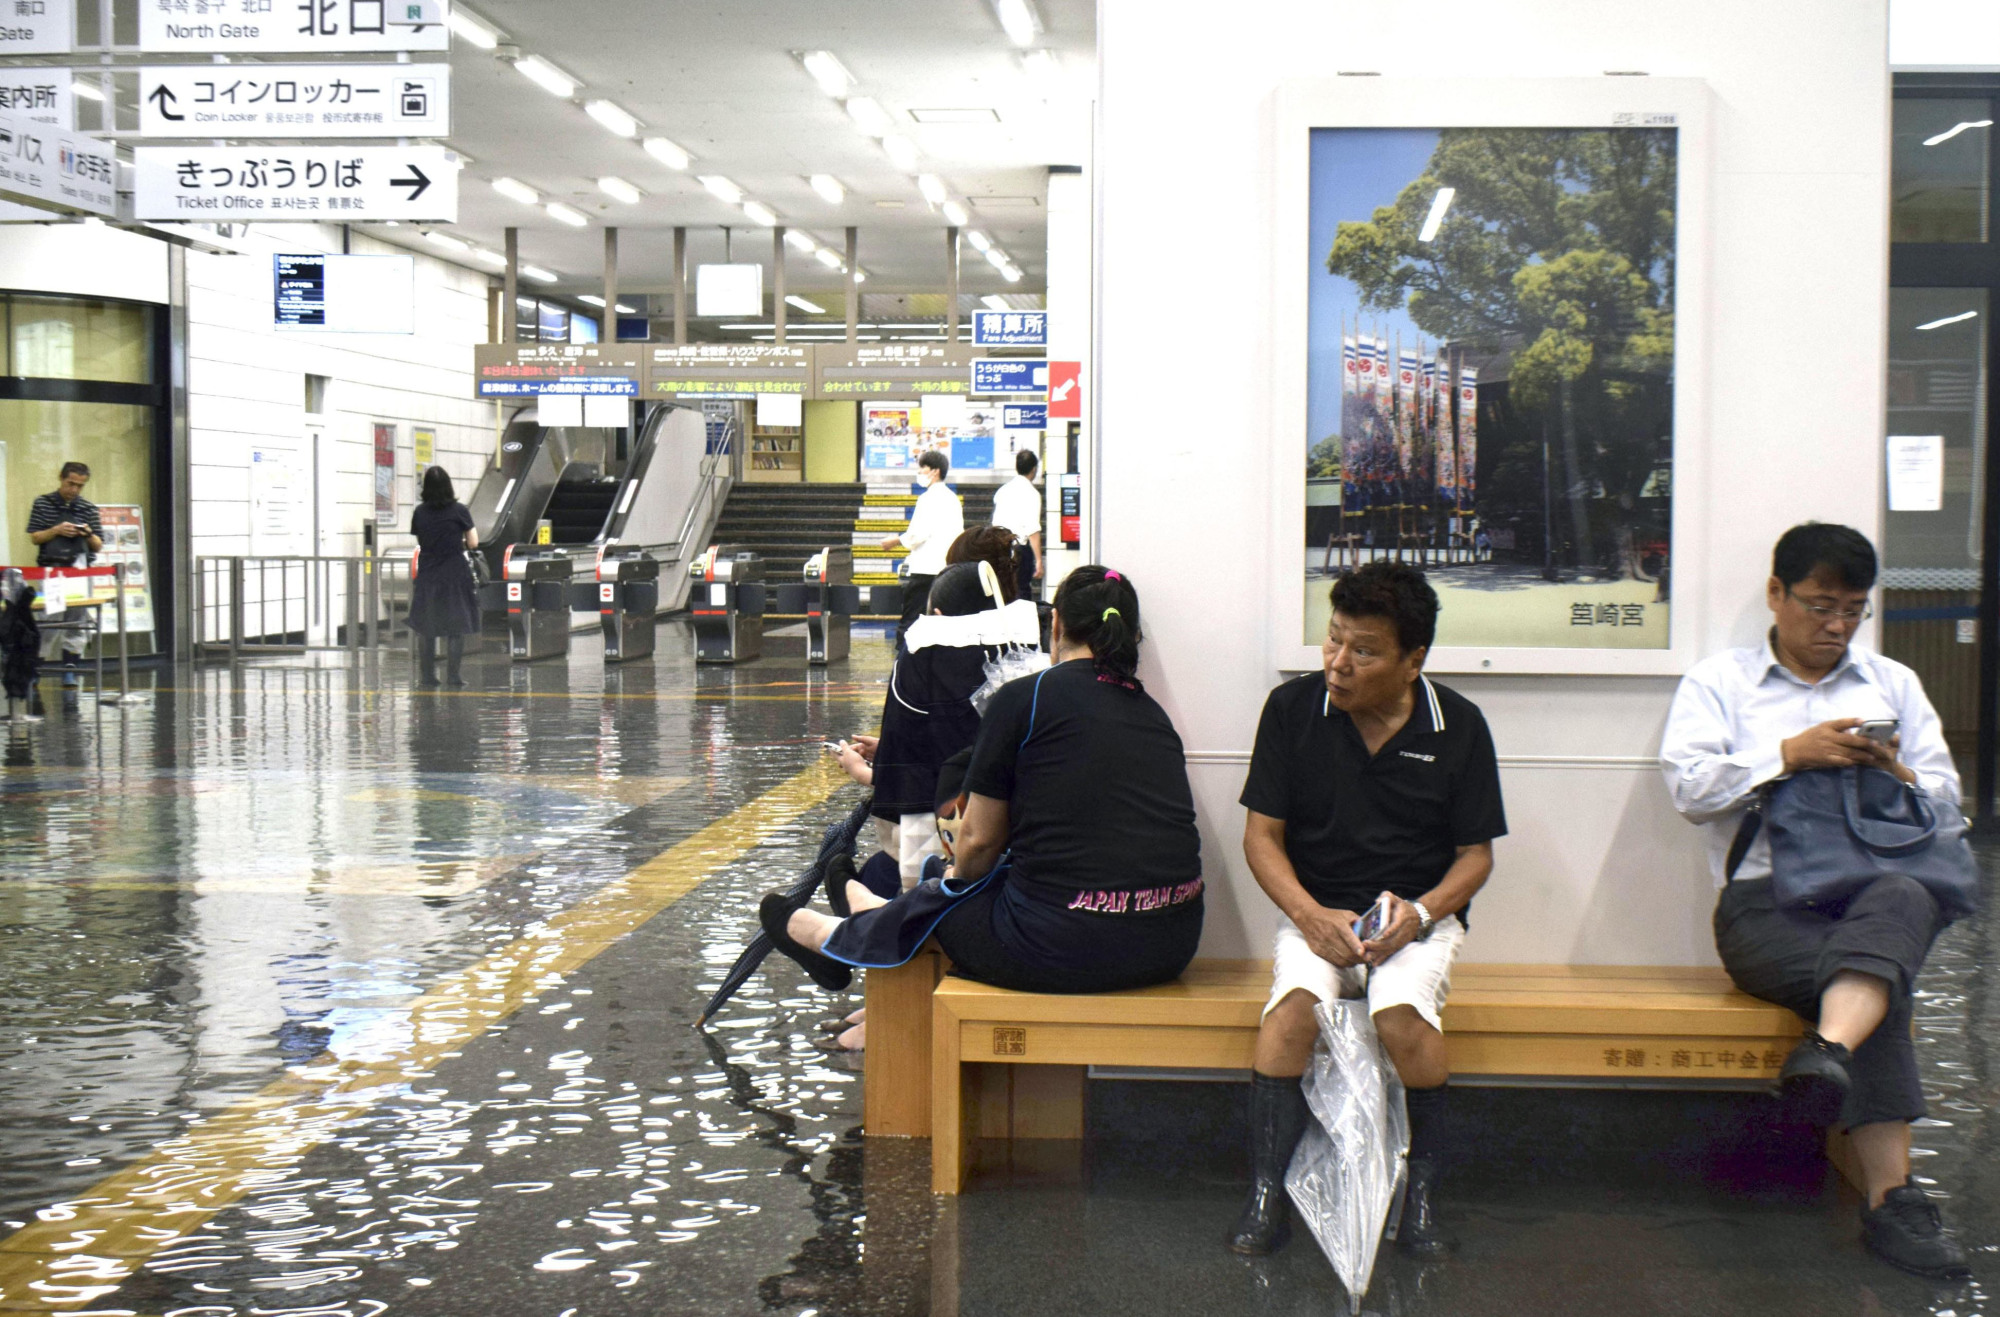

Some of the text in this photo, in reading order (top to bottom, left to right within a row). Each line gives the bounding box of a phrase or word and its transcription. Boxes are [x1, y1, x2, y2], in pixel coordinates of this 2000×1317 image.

[166, 24, 260, 38] North Gate
[297, 0, 385, 36] 北口
[193, 78, 381, 105] コインロッカー
[195, 112, 259, 123] Coin Locker
[15, 133, 45, 165] バス
[176, 158, 365, 189] きっぷうりば
[176, 195, 264, 209] Ticket Office
[1067, 889, 1131, 914] JAPAN
[1133, 886, 1173, 911] TEAM
